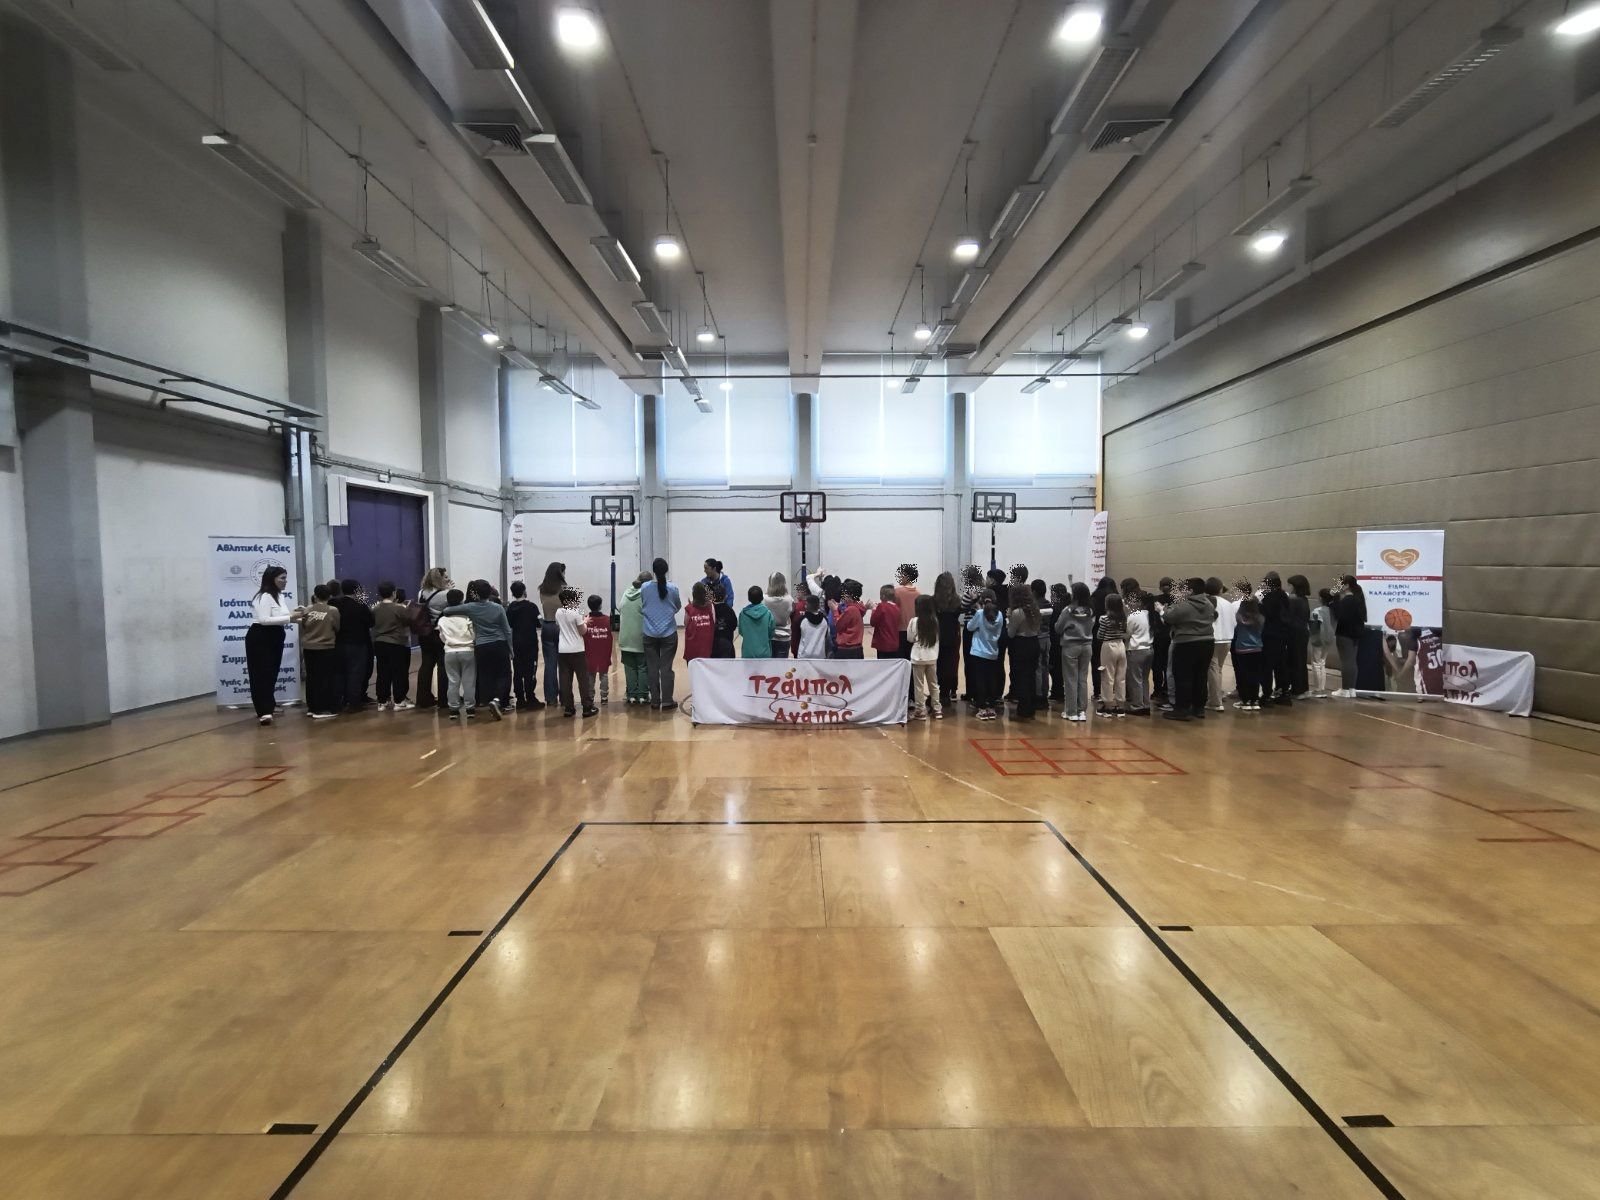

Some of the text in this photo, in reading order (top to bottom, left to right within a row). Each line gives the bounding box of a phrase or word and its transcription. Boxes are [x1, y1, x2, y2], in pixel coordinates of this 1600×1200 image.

[216, 544, 290, 553] Αθλητικές Αξίες
[219, 599, 253, 608] Ισότητ
[749, 674, 852, 700] Τζάμπολ
